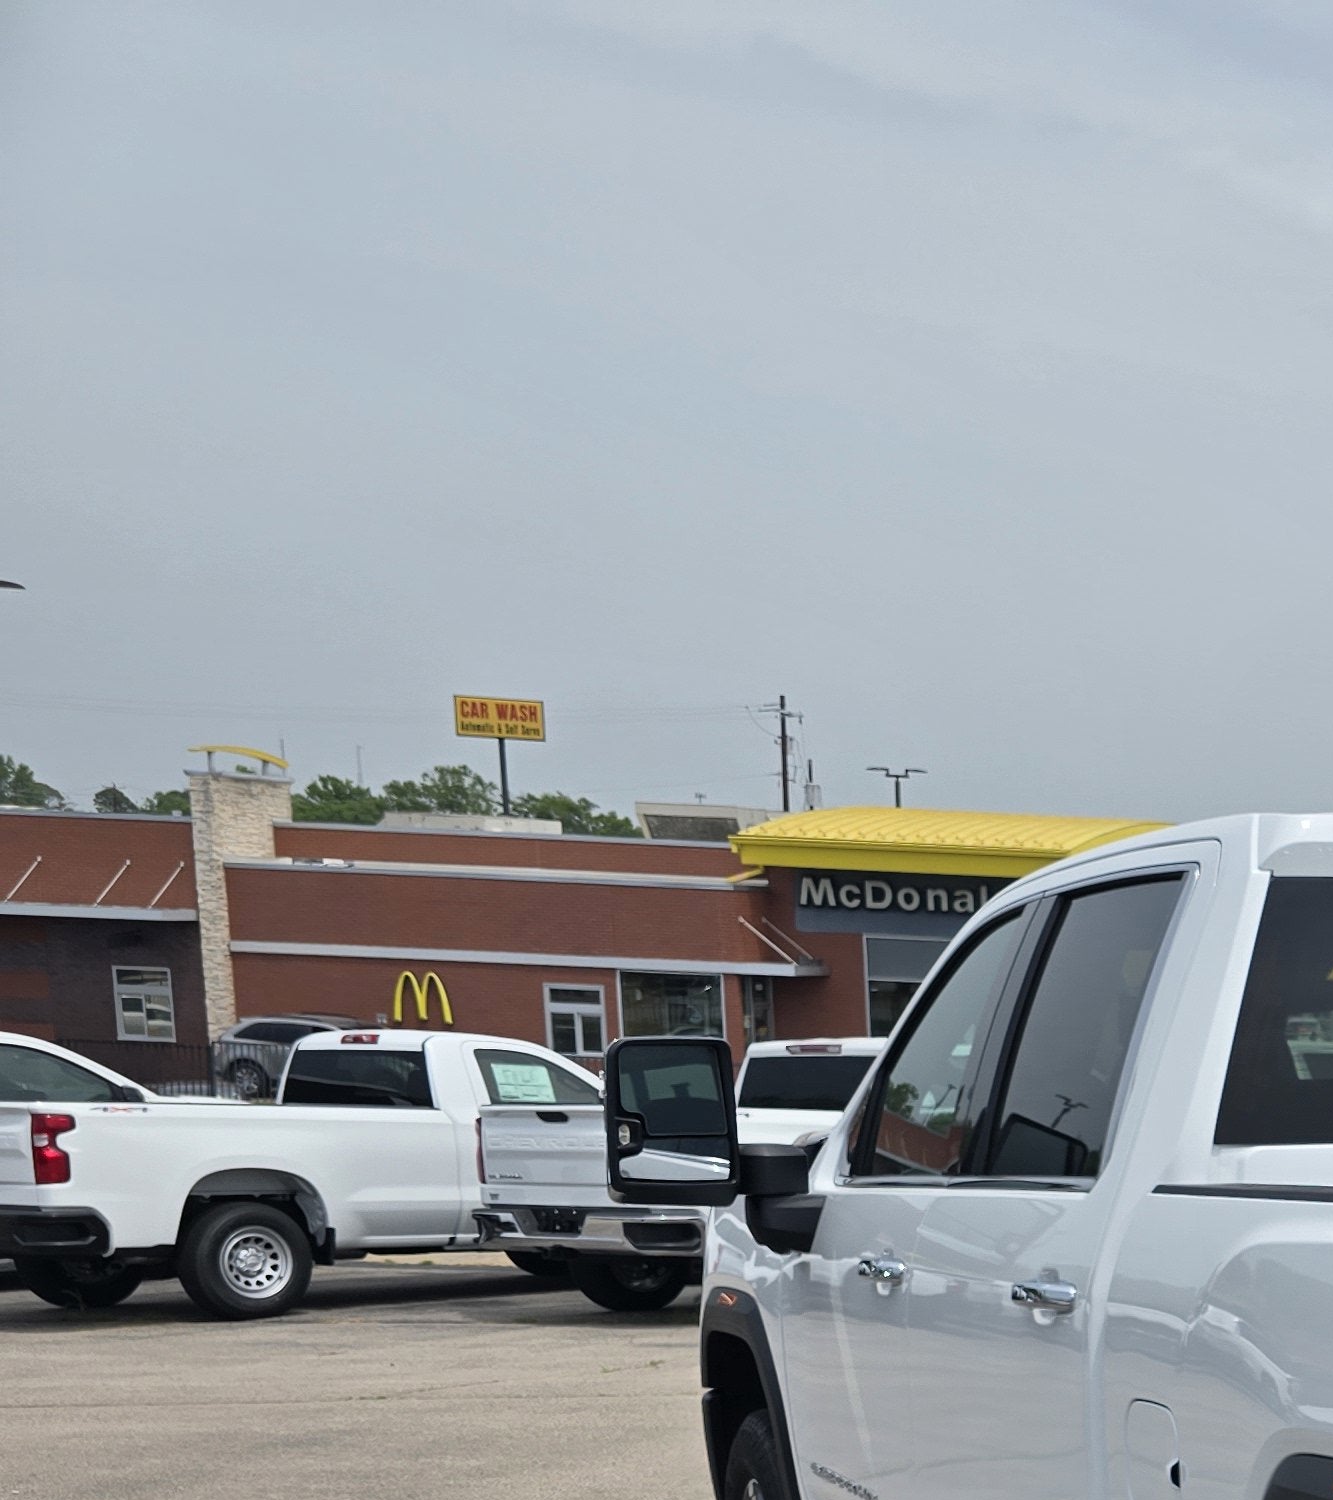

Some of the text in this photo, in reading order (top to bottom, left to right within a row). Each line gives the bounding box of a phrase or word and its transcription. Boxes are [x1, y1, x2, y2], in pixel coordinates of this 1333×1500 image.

[461, 701, 538, 723] CAR WASH
[800, 877, 994, 913] McDonal
[488, 1134, 606, 1149] CHEVROLE
